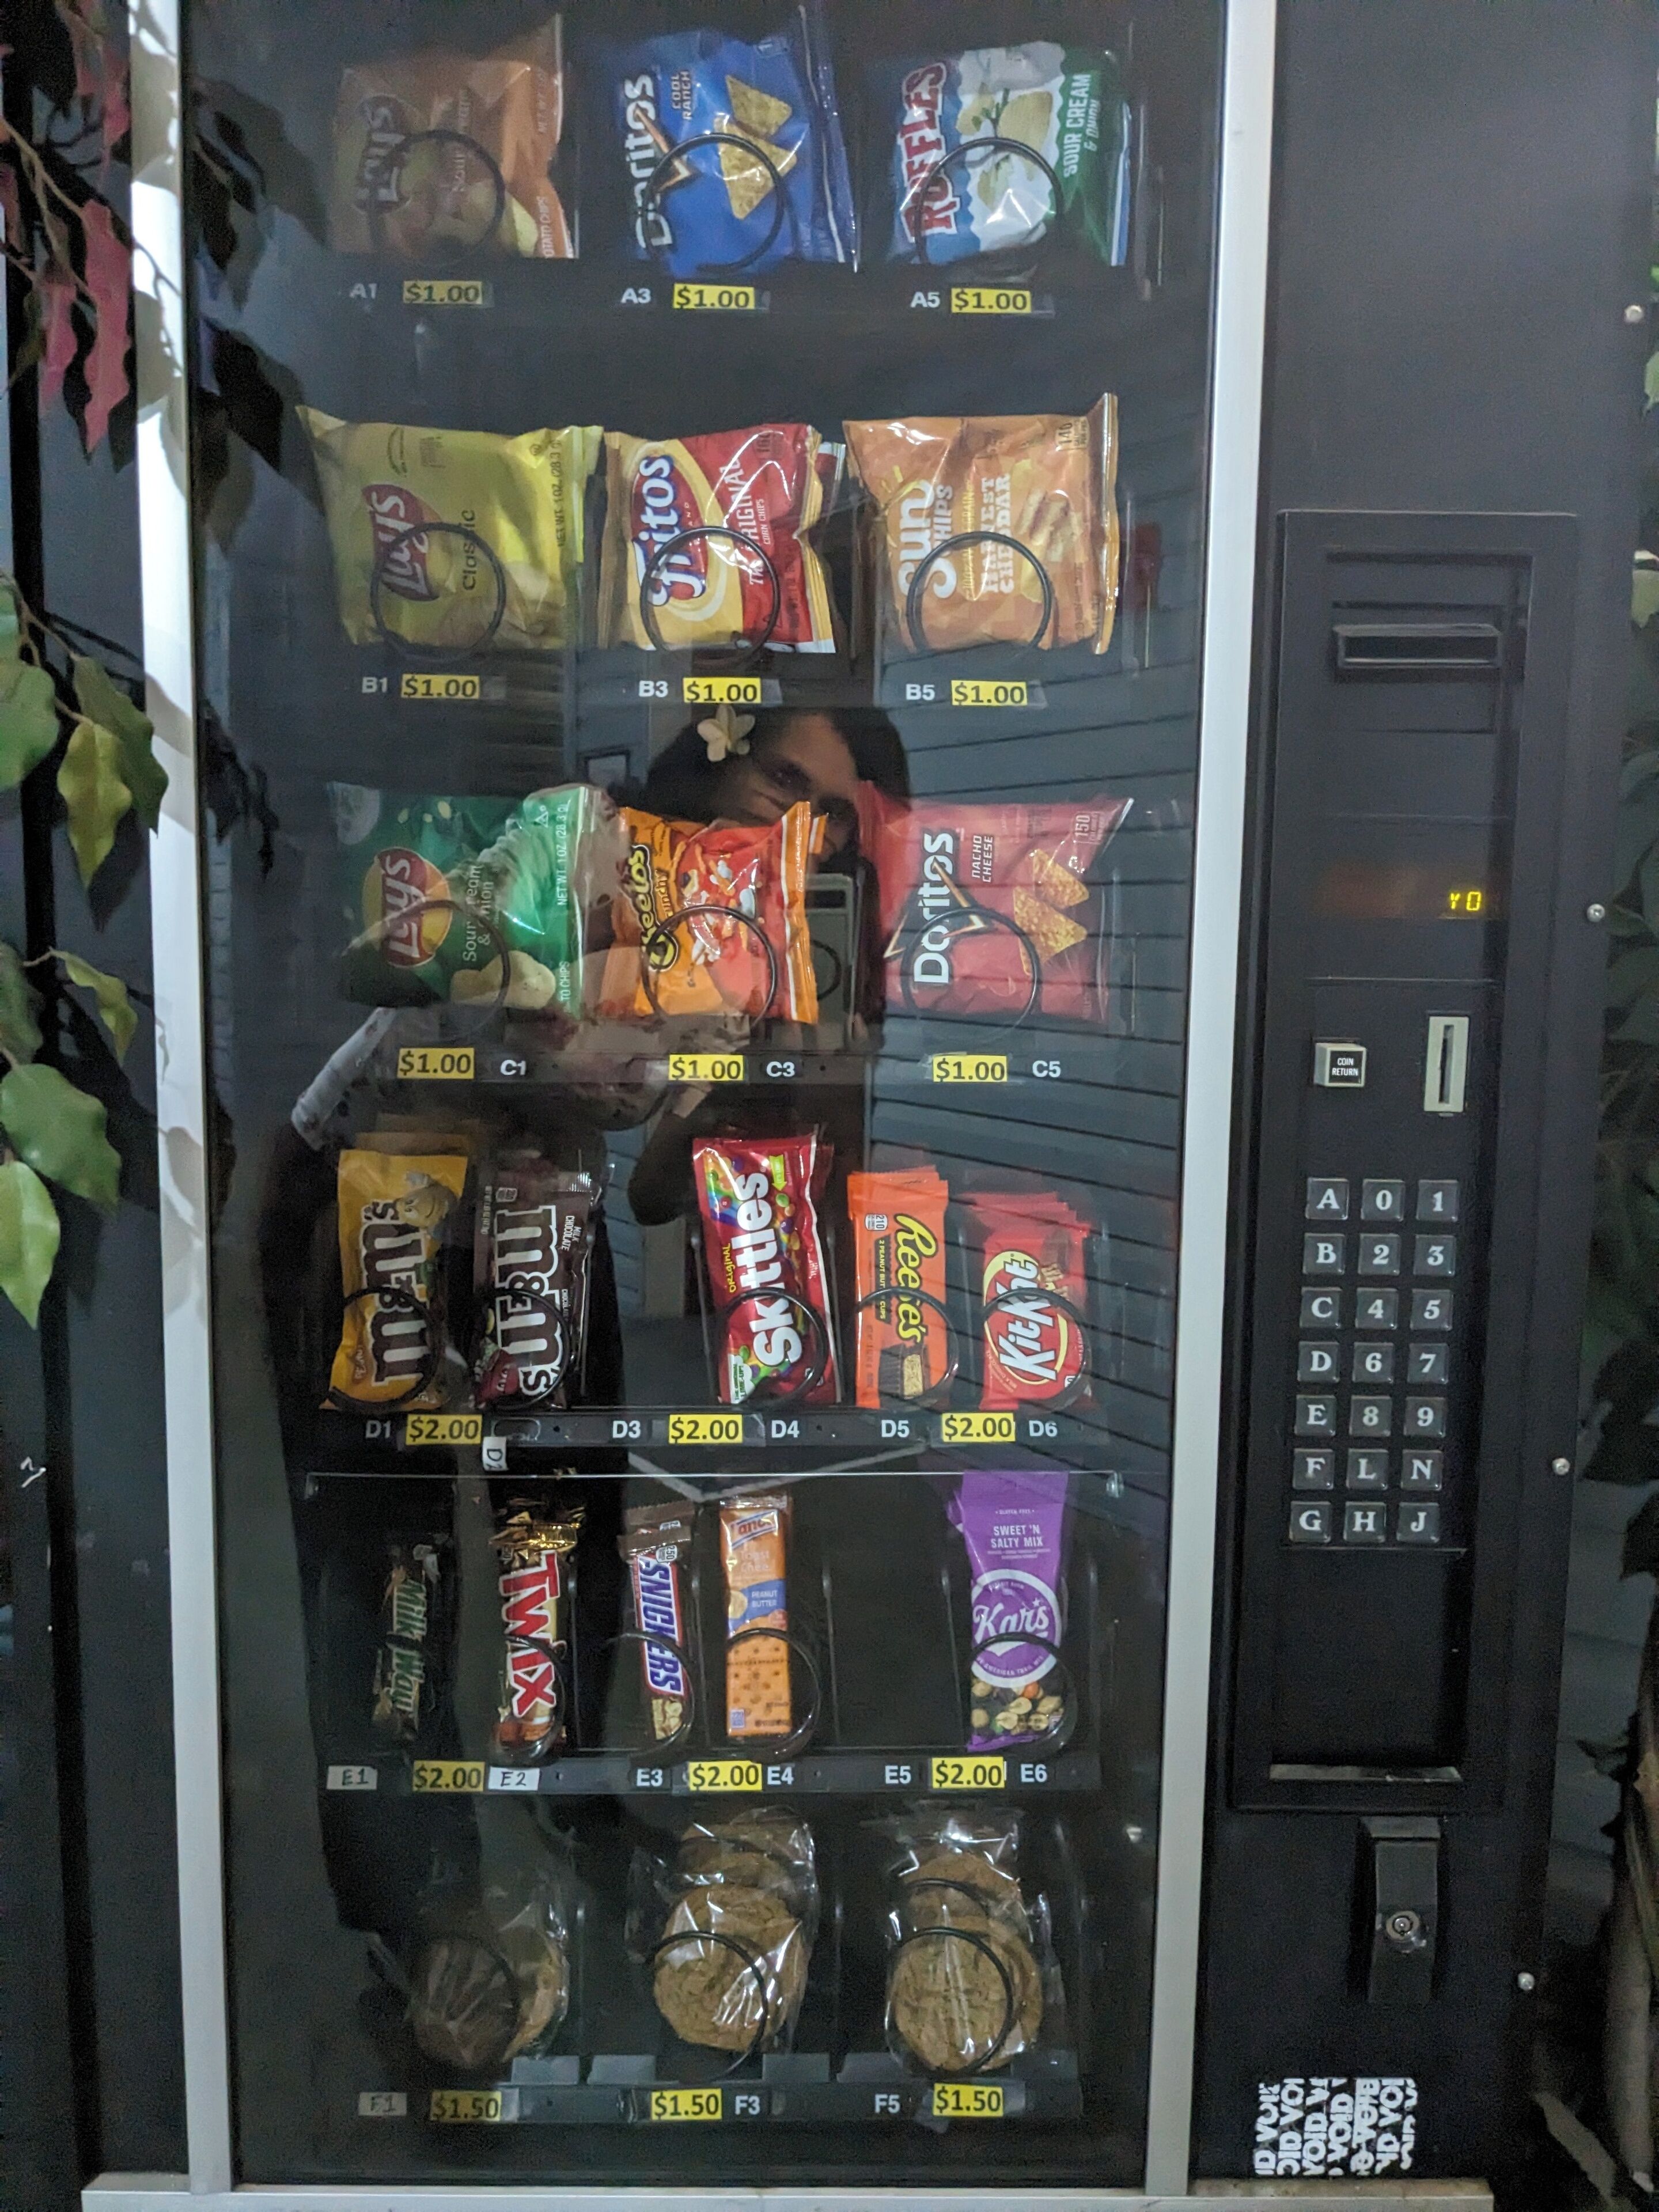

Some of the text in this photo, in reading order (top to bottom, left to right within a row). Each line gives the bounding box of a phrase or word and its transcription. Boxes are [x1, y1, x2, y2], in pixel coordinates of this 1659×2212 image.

[672, 73, 681, 109] COOL
[681, 71, 692, 120] RANCH
[1063, 74, 1091, 177] SOUR CREAM
[349, 282, 479, 304] A1 $1.00
[621, 286, 749, 309] A3 $1.00
[911, 290, 1027, 310] A5 $1.00
[933, 484, 953, 554] HIPS
[460, 510, 478, 592] Clasic
[897, 479, 957, 599] Sun
[362, 675, 476, 698] B1 $1.00
[639, 681, 758, 703] B3 $1.00
[906, 683, 1025, 704] B5 $1.00
[1074, 814, 1091, 837] 150
[971, 834, 982, 878] NACHO
[983, 835, 993, 883] CHEESE
[557, 888, 567, 906] NET
[463, 865, 482, 962] Sour ream
[478, 933, 491, 946] &
[400, 1051, 527, 1076] $1.00 C1
[672, 1057, 795, 1081] $1.00 C3
[936, 1058, 1061, 1082] $1.00 C5
[1332, 1067, 1359, 1077] RETURN
[1338, 1058, 1354, 1066] COIN
[1318, 1188, 1340, 1210] A
[1433, 1191, 1444, 1212] 1
[561, 1215, 575, 1251] CHOCOLATE
[876, 1214, 885, 1229] 210
[573, 1226, 582, 1243] MILK
[1317, 1243, 1444, 1266] B 2 3
[1311, 1297, 1441, 1320] C 4 5
[1310, 1350, 1436, 1374] D 6 7
[881, 1415, 1058, 1441] D5 $2.00 D6
[1307, 1404, 1434, 1429] E 8 9
[366, 1417, 479, 1442] D1 $2.00
[612, 1419, 800, 1443] D3 $2.00 D4
[1306, 1458, 1433, 1480] F L N
[994, 1525, 1027, 1536] SWEET
[1300, 1510, 1427, 1533] G H J
[665, 1546, 677, 1560] 250
[991, 1536, 1044, 1549] SALTY MIX
[752, 1590, 777, 1599] PEANUT
[752, 1599, 777, 1608] BUTTER
[342, 1768, 369, 1785] E1
[415, 1764, 482, 1791] $2.00
[500, 1770, 527, 1787] E2
[637, 1764, 794, 1790] E3 $2.00 E4
[885, 1760, 1048, 1786] E5 $2.00 E6
[433, 2094, 499, 2121] $1.50
[655, 2091, 760, 2119] $1.50 F3
[875, 2088, 1002, 2115] F5 $1.50
[1327, 2093, 1353, 2162] VOID
